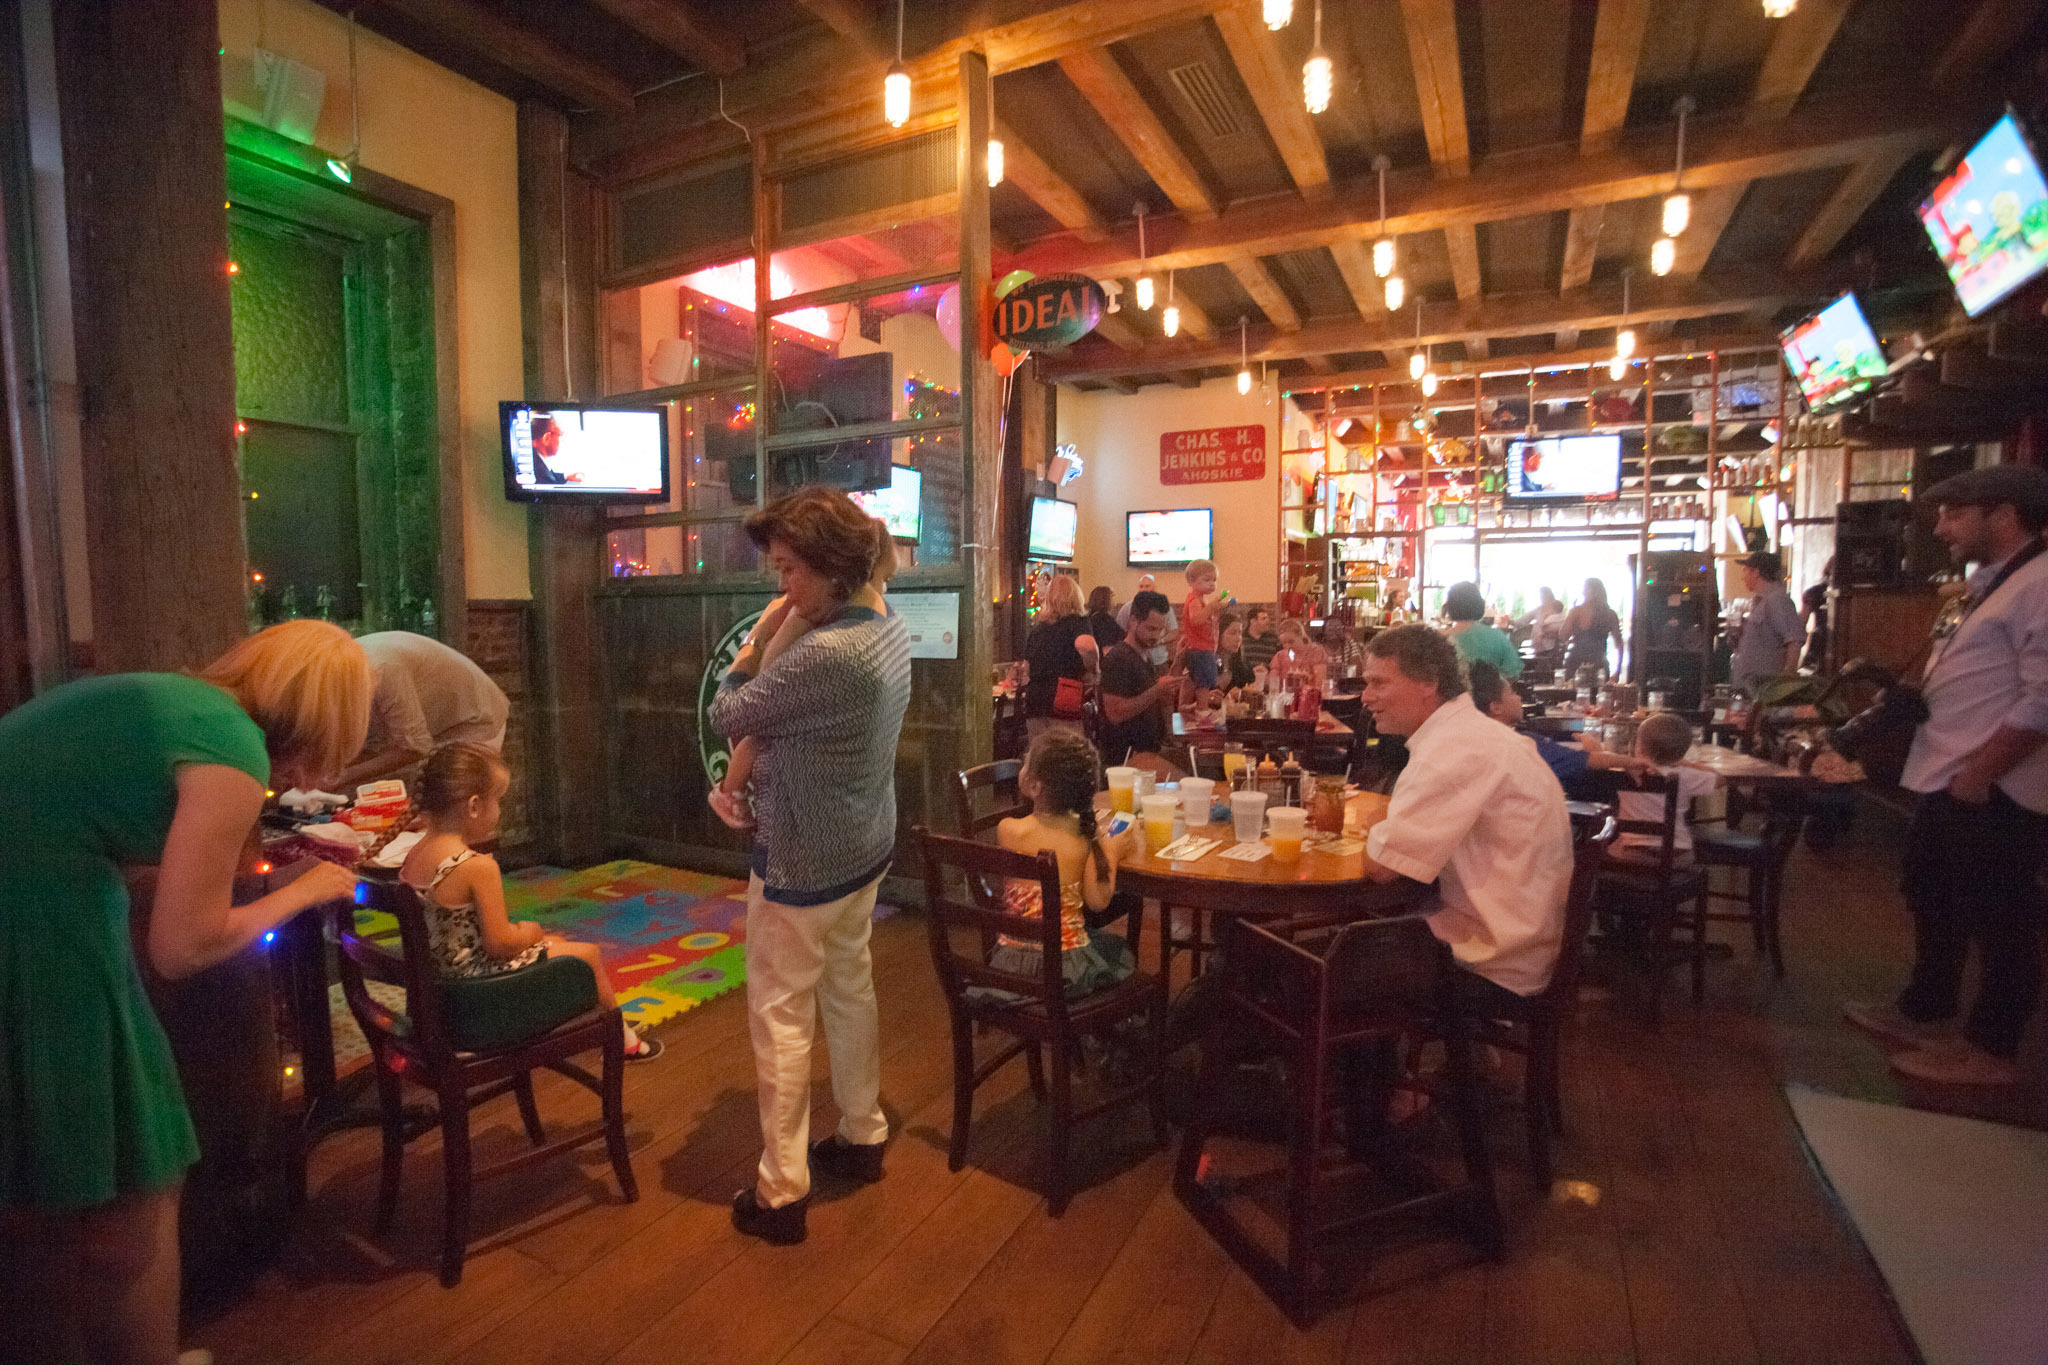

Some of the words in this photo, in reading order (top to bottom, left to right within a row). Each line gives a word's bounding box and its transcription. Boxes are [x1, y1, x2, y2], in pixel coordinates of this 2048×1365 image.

[1175, 431, 1223, 450] CHAS.
[1161, 449, 1227, 470] JENKINS
[1183, 467, 1244, 481] AHOSKIE
